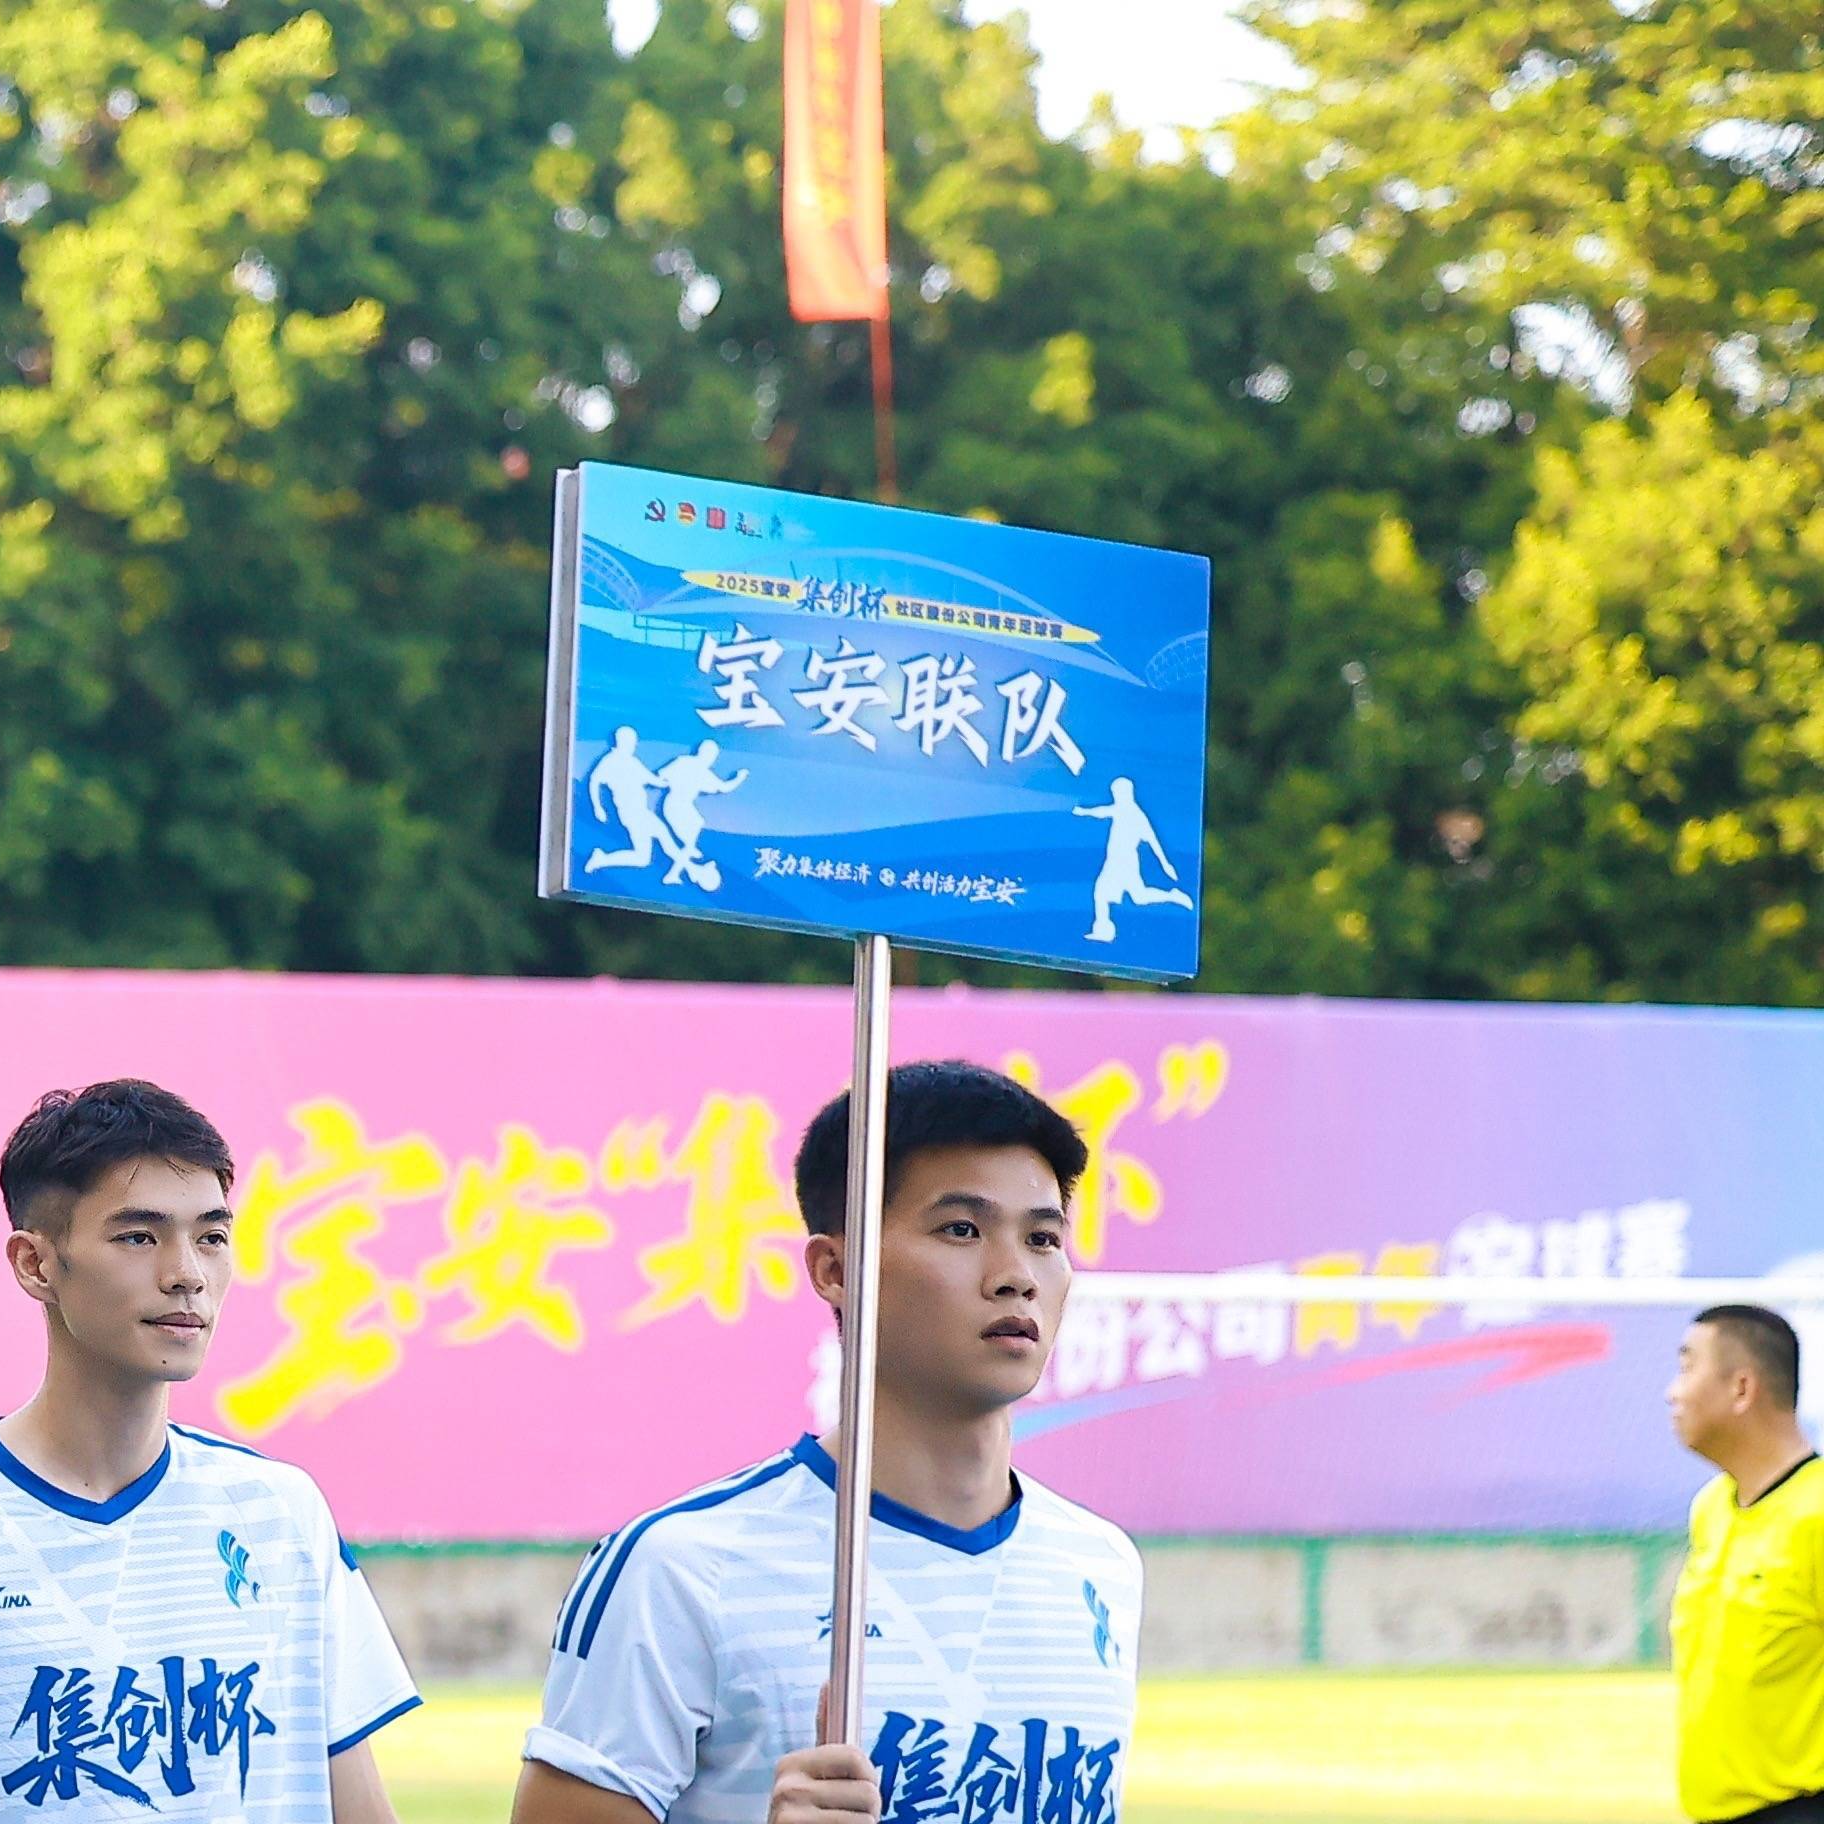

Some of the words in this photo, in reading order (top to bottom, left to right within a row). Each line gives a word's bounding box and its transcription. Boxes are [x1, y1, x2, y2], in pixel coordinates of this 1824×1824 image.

[695, 623, 1087, 776] 宝安联队
[754, 847, 872, 885] 聚力集体经济
[901, 868, 1026, 905] 共创活力宝安
[1, 1655, 277, 1814] 集创杯
